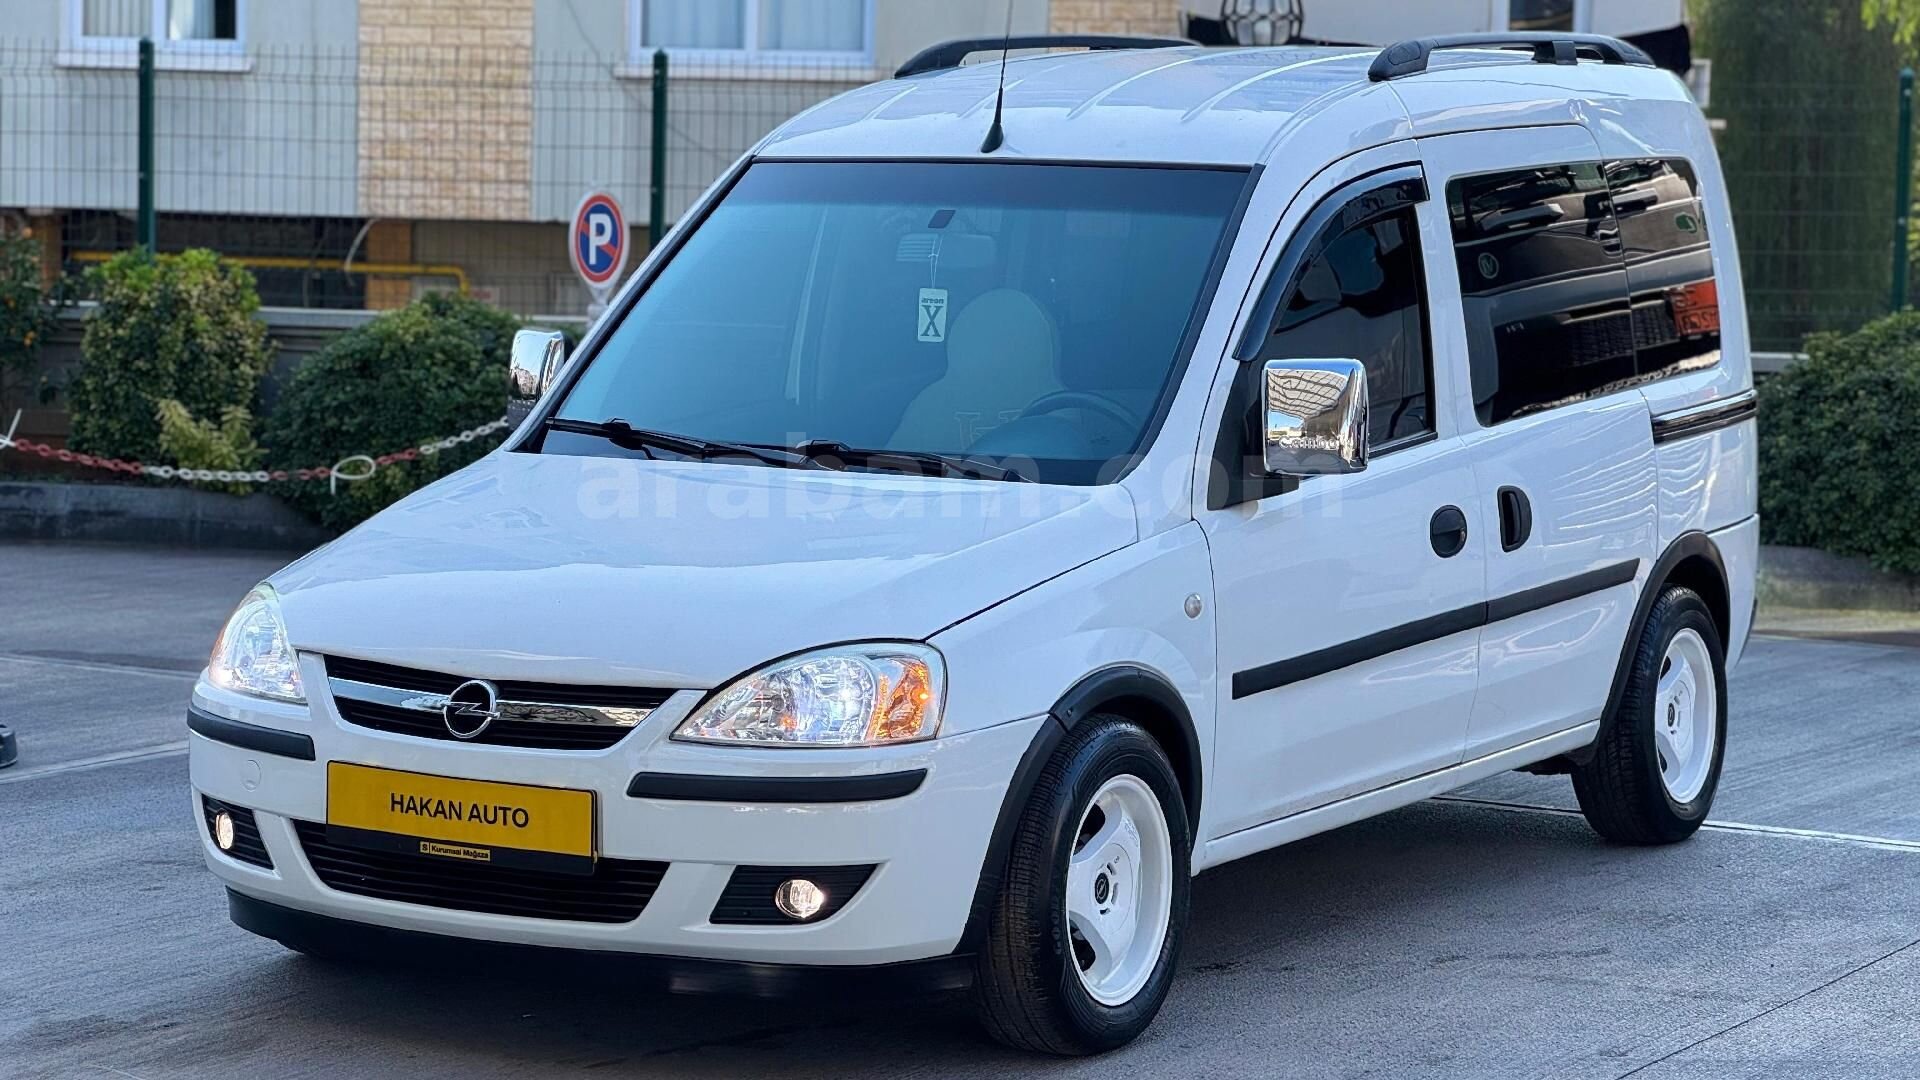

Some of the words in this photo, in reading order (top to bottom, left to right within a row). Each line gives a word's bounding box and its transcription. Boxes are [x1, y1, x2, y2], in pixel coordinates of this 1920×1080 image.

[589, 213, 612, 265] P
[921, 305, 944, 337] X
[390, 793, 462, 821] HAKAN
[467, 803, 529, 828] AUTO
